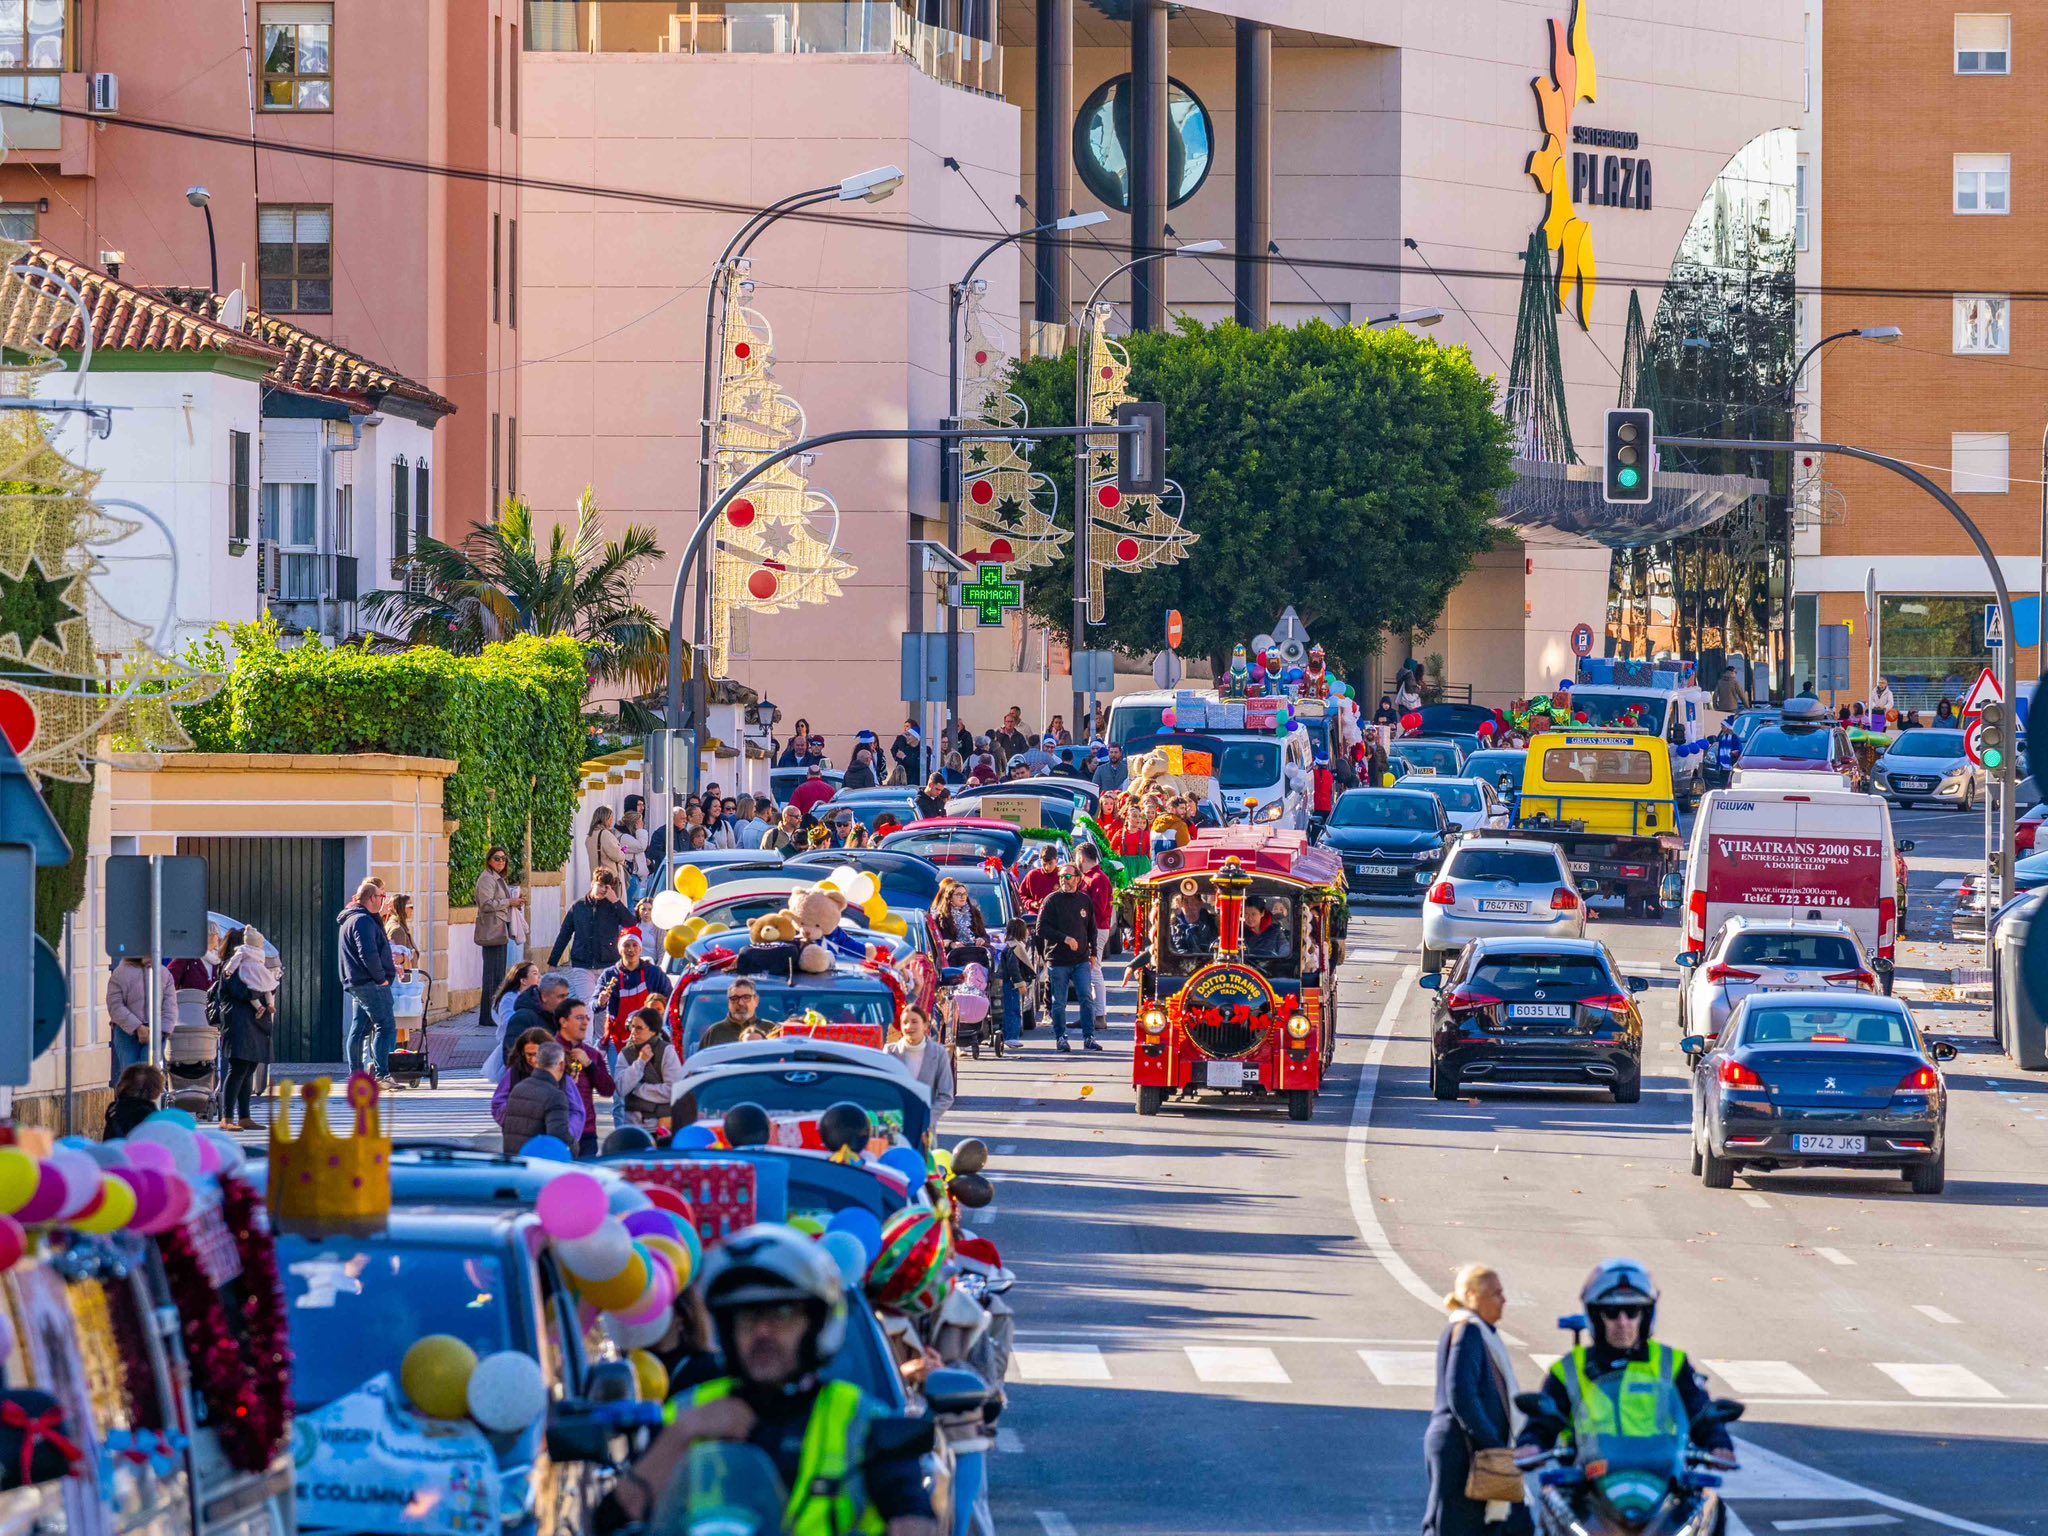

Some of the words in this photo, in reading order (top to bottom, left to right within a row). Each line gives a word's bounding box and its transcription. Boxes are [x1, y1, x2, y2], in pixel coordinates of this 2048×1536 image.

[1573, 152, 1652, 210] PLAZA
[970, 590, 1012, 600] FARMACIA
[1716, 802, 1754, 811] IGLUVAN
[1725, 840, 1814, 856] TIRATRANS
[1819, 844, 1849, 856] 2000
[1853, 846, 1880, 857] S.L.
[1741, 854, 1785, 862] ENTREGA
[1803, 856, 1848, 864] COMPRAS
[1773, 862, 1826, 870] DOMICILIO
[1752, 886, 1837, 896] www.tiratrans2000.com
[1742, 892, 1774, 903] Teléf.
[1780, 895, 1800, 904] 722
[1805, 896, 1826, 905] 340
[1831, 896, 1850, 906] 104
[1486, 901, 1506, 910] 7647
[1508, 902, 1525, 910] FNS
[1196, 974, 1226, 994] DOTTO
[1229, 974, 1260, 998] TRAINS
[1204, 984, 1247, 998] CASTELFRANCO
[1516, 1006, 1543, 1016] 6035
[1548, 1007, 1567, 1016] LXL
[1802, 1138, 1832, 1148] 9742
[1838, 1138, 1862, 1150] JKS
